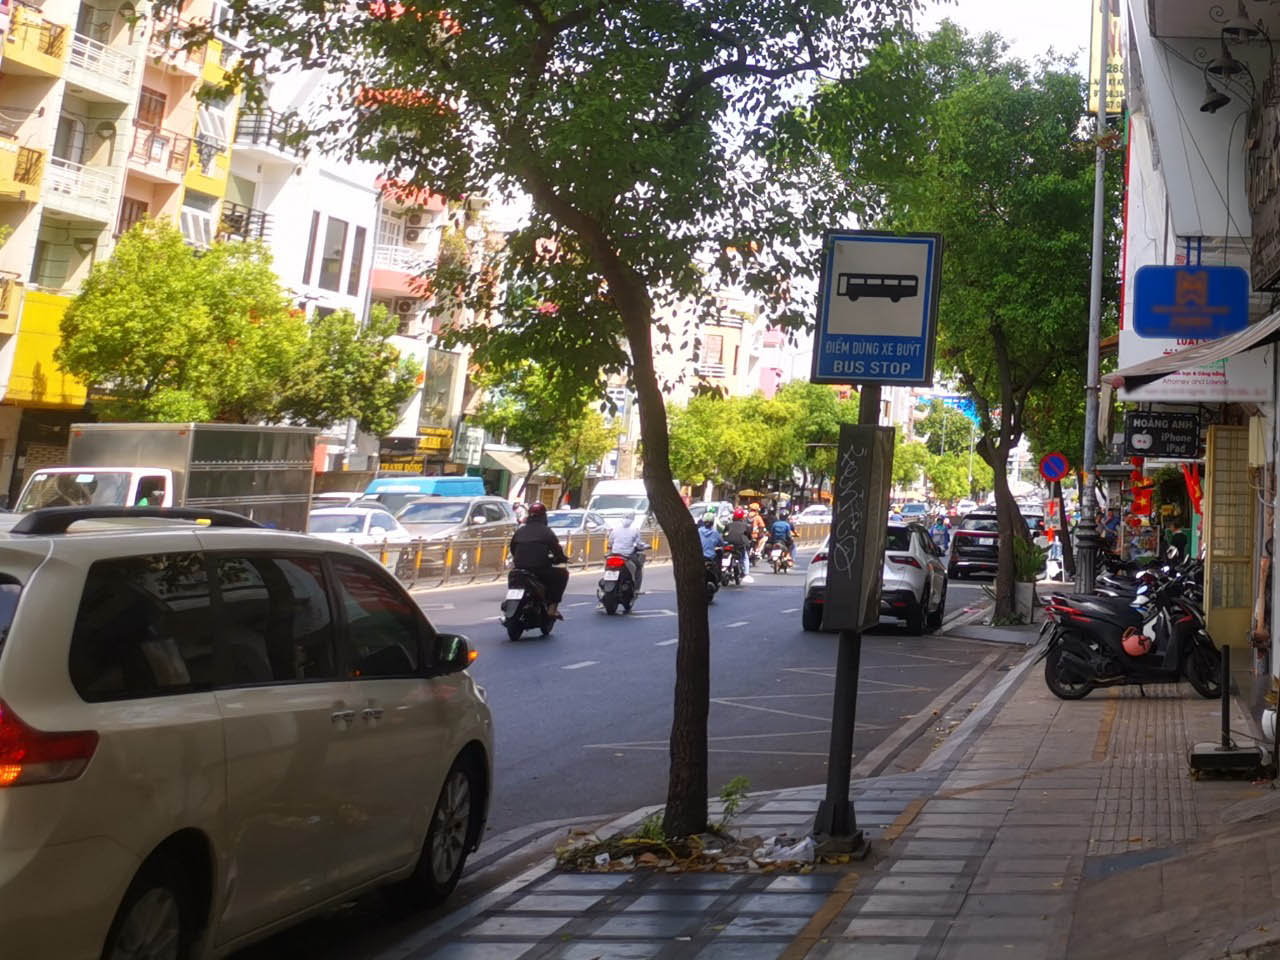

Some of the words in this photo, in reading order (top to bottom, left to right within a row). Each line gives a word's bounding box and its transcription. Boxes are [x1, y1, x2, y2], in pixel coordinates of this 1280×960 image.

[881, 342, 895, 356] XE
[833, 360, 864, 374] BUS
[870, 361, 911, 375] STOP
[1171, 420, 1193, 429] ANH
[1161, 432, 1192, 443] iPhone
[1166, 442, 1186, 453] iPad
